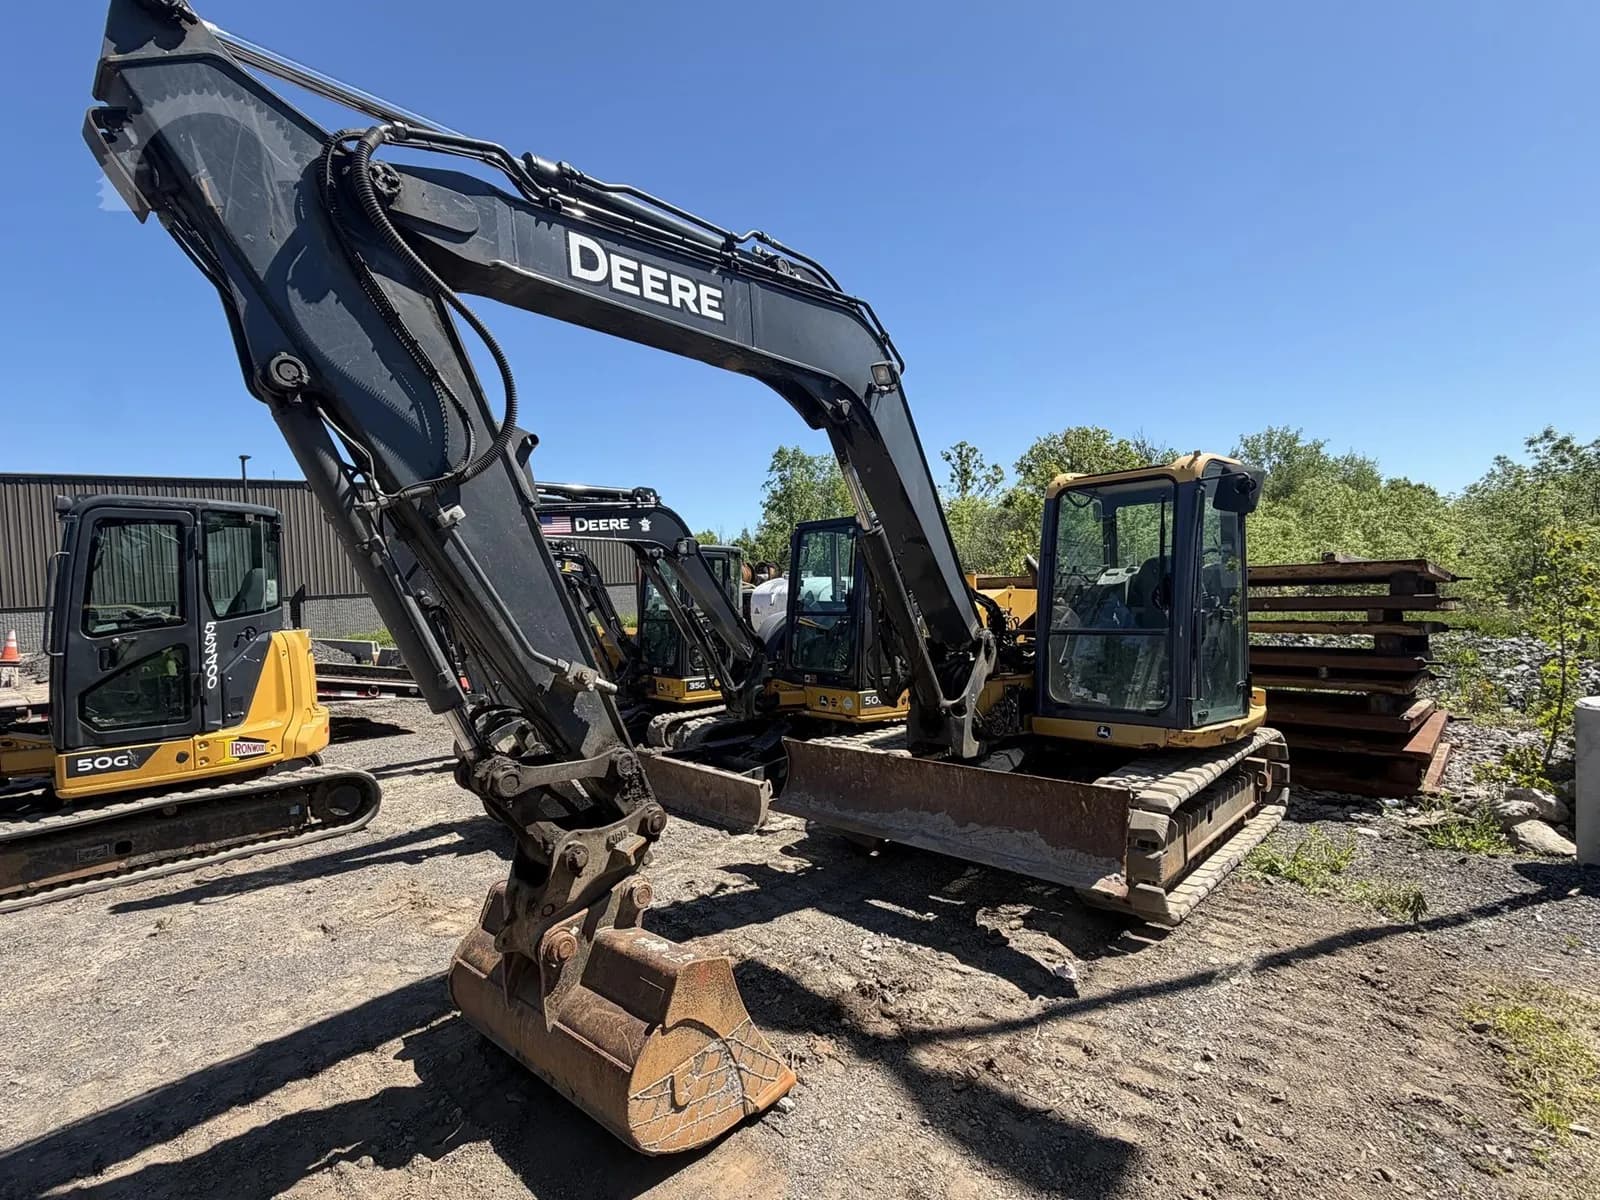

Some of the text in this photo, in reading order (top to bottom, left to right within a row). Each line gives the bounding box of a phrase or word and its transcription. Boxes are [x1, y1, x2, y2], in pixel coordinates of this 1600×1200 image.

[568, 231, 725, 321] DEERE
[575, 518, 630, 532] DEERE
[204, 621, 218, 689] 554400
[864, 695, 882, 705] 50
[77, 755, 129, 771] 50G
